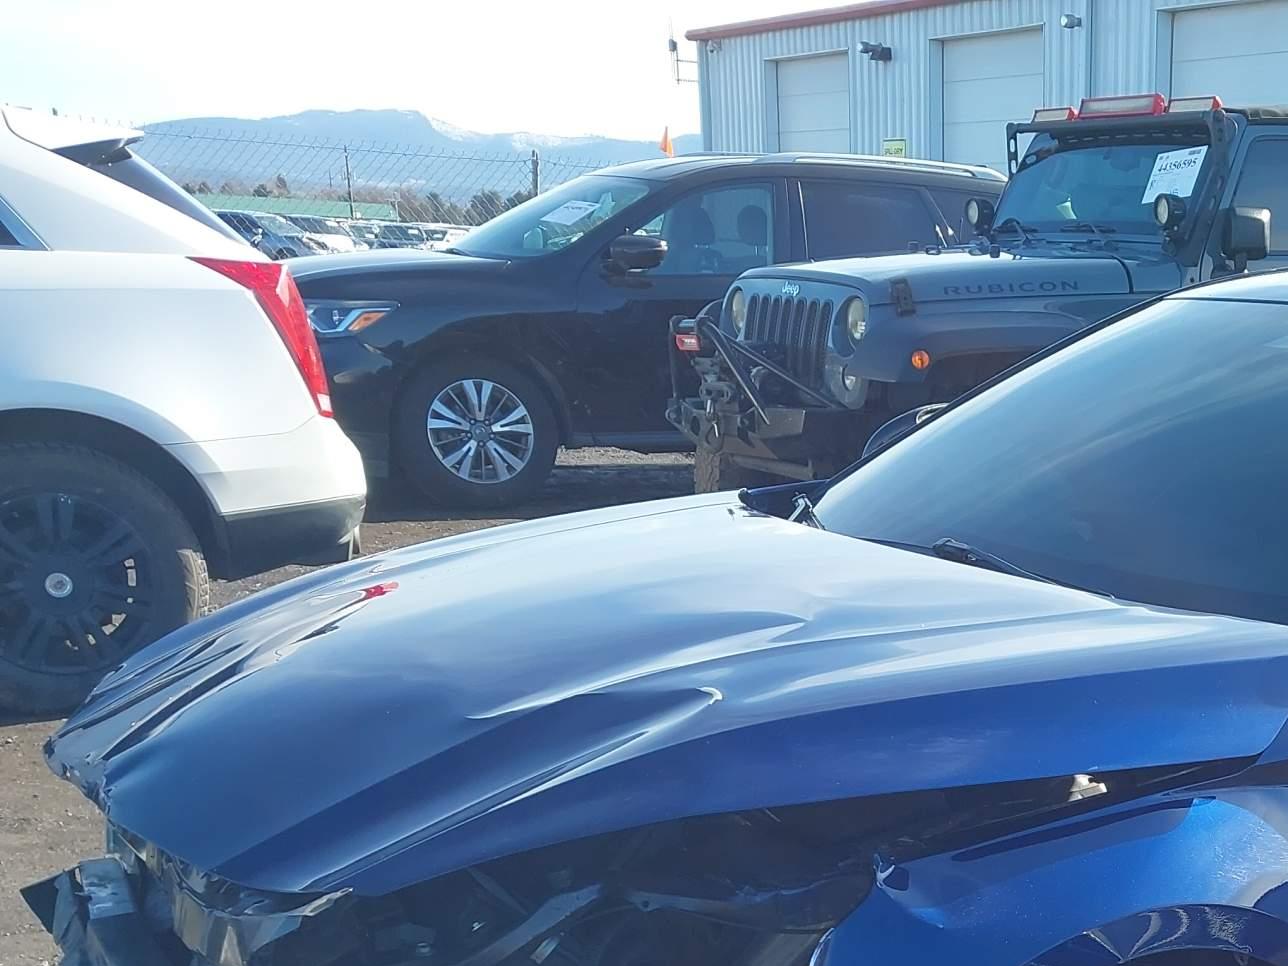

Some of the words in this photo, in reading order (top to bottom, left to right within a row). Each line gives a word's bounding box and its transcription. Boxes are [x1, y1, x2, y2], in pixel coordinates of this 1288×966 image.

[1158, 158, 1198, 173] 44356595
[782, 280, 800, 297] Jeep
[943, 280, 1080, 295] RUBICON
